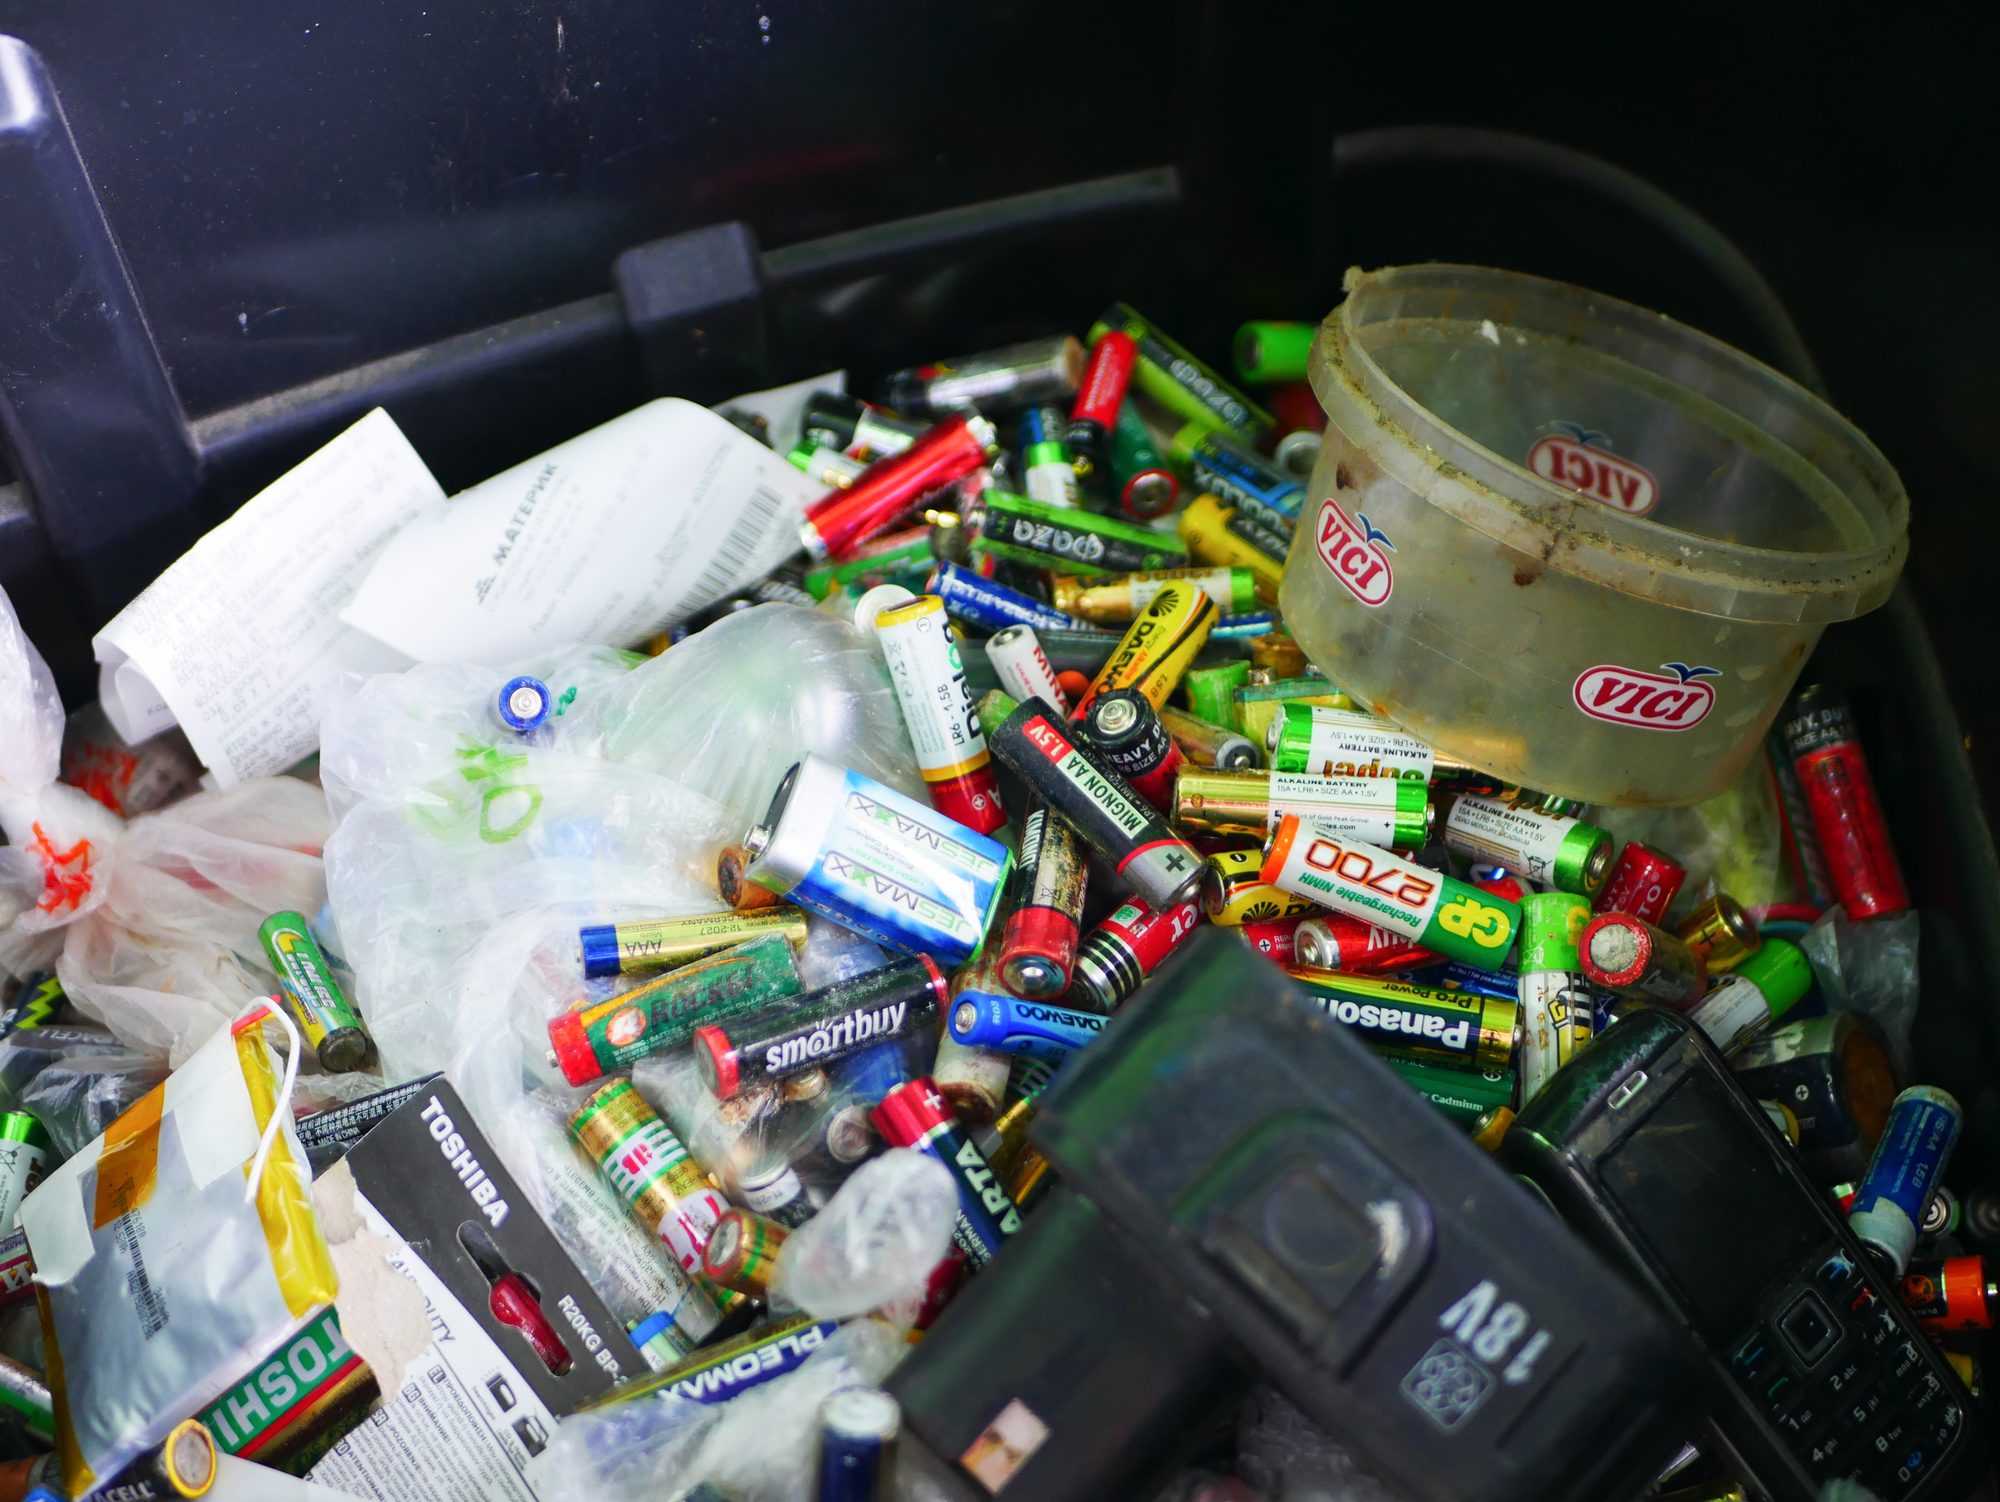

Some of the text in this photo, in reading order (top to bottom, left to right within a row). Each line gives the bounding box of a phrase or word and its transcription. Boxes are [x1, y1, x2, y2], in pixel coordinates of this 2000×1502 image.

[495, 462, 558, 566] МАТЕРИК
[1319, 515, 1385, 590] VICI
[1596, 678, 1706, 721] VICI
[951, 722, 965, 746] LR6
[1030, 723, 1065, 757] 1.5V
[1330, 731, 1348, 741] 1.5V
[1354, 733, 1367, 742] AA
[1369, 735, 1387, 745] SIZE
[1392, 737, 1410, 747] LR6
[1132, 751, 1156, 771] SIZE
[1157, 737, 1168, 754] AA
[1338, 743, 1428, 759] ALKALINE BATTERY
[1066, 755, 1142, 831] MIGNON AA
[1277, 777, 1369, 789] ALKALINE BATTERY
[1277, 785, 1291, 793] 15A
[1297, 786, 1314, 795] LR6
[1320, 787, 1340, 796] SIZE
[1360, 789, 1378, 798] 1.5V
[1457, 806, 1473, 817] 15A
[1474, 811, 1491, 823] LR6
[1495, 818, 1515, 831] SIZE
[1462, 799, 1509, 822] ALKALINE
[1504, 811, 1542, 830] BATTERY
[854, 797, 993, 871] JESMAXX
[1298, 872, 1335, 894] NiMH
[1304, 837, 1436, 909] 2700
[832, 856, 972, 933] JESMAXX
[1335, 881, 1422, 928] Rechargeable
[681, 914, 736, 927] GERMANY
[700, 923, 743, 936] 12-2027
[625, 938, 663, 957] AAA
[1382, 983, 1472, 1010] Pro Power
[1016, 1004, 1102, 1031] DAEWOO
[767, 1001, 907, 1075] smartbuy
[1431, 1093, 1484, 1112] Cadmium
[343, 1126, 361, 1140] CHINA
[420, 1095, 510, 1228] TOSHIBA
[563, 1160, 596, 1200] вызвать
[955, 1138, 1022, 1235] ARTA
[956, 1209, 992, 1266] GERMAN
[558, 1295, 600, 1351] R20KG
[1439, 1278, 1552, 1387] 18V
[1874, 1330, 1887, 1345] def
[428, 1364, 446, 1384] EL
[657, 1324, 825, 1402] PLEOMAX
[212, 1315, 355, 1447] TOSHI
[1830, 1365, 1858, 1391] 2 abc
[402, 1384, 421, 1403] BG
[1853, 1406, 1866, 1422] 5
[1812, 1448, 1824, 1462] 4
[1875, 1436, 1889, 1453] 8
